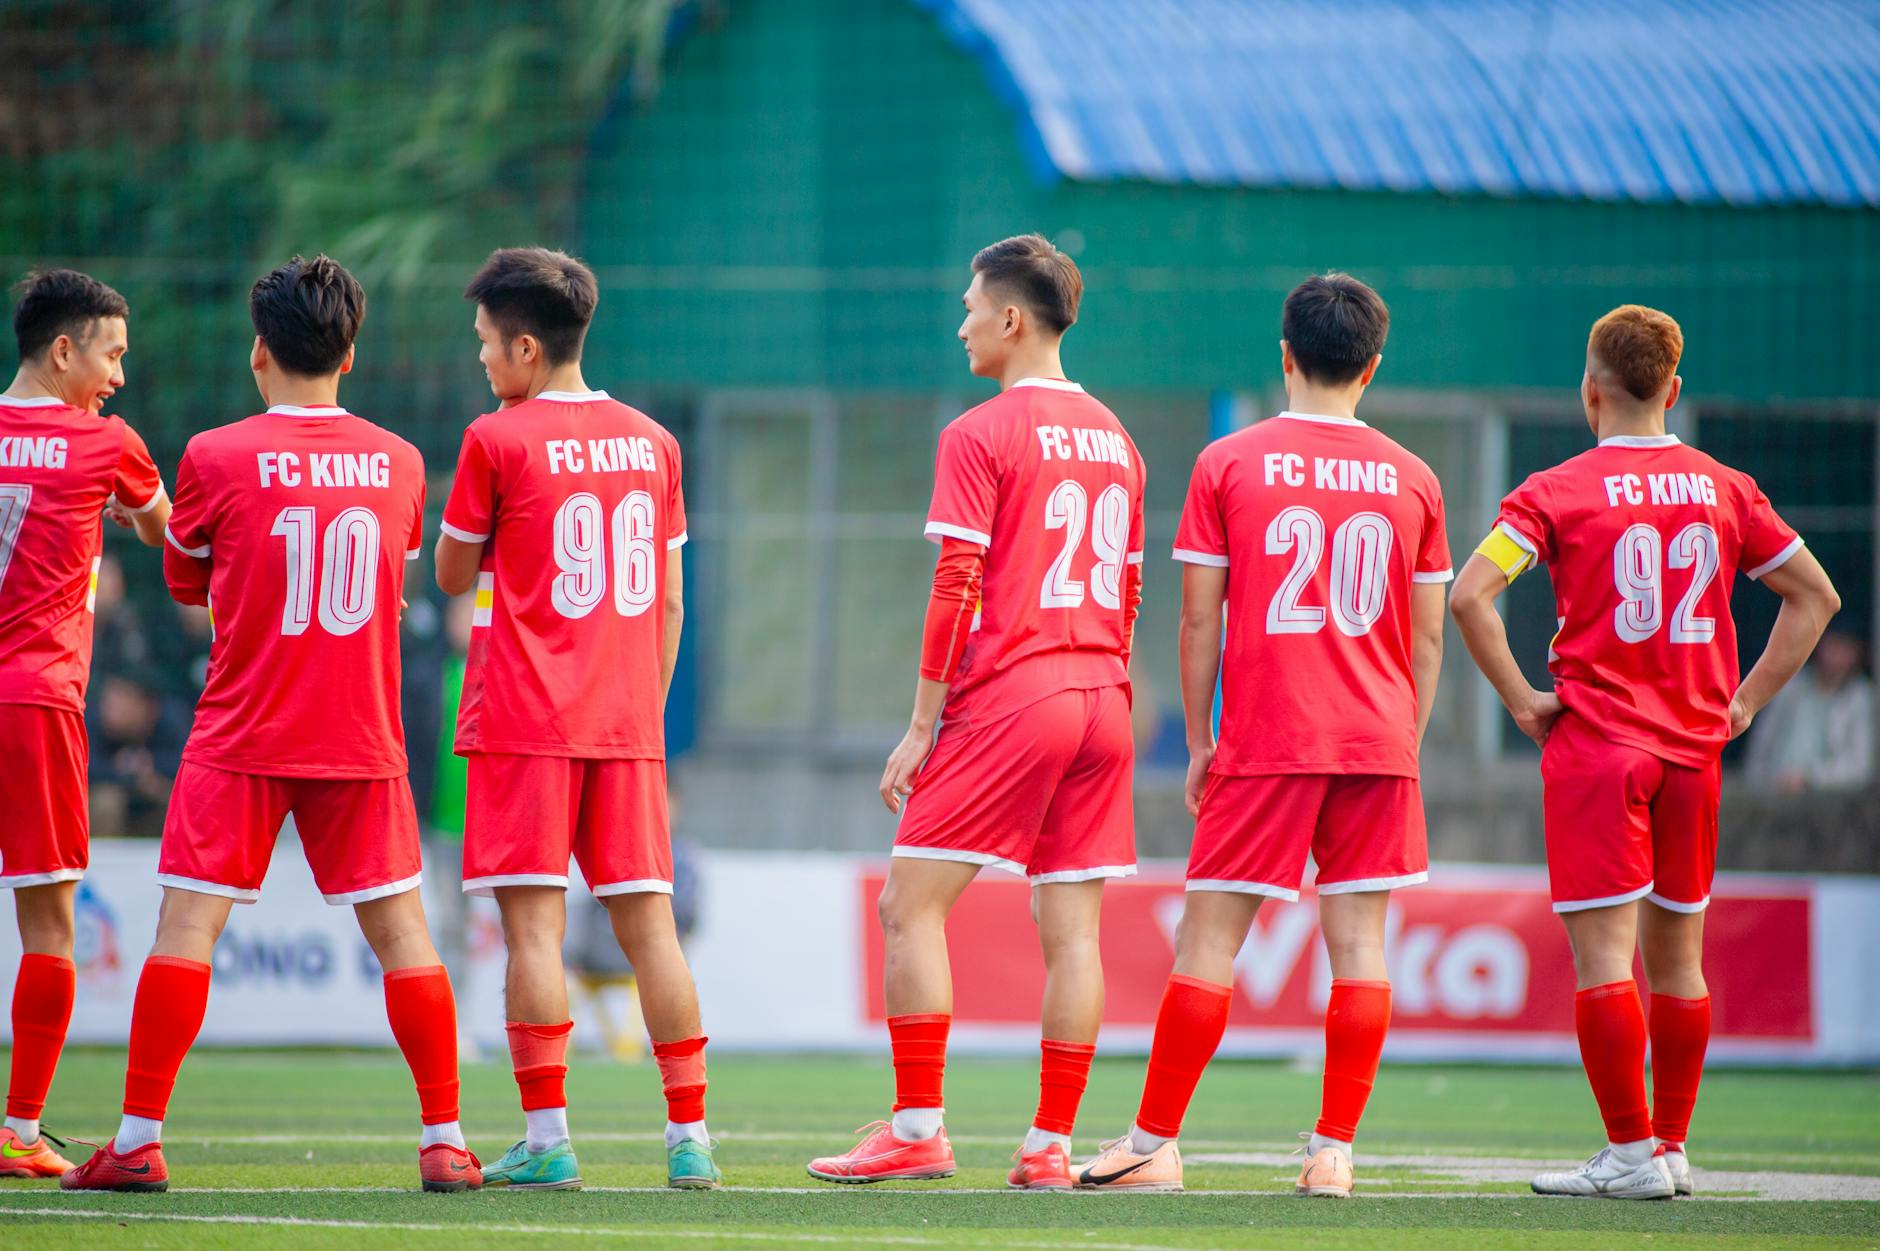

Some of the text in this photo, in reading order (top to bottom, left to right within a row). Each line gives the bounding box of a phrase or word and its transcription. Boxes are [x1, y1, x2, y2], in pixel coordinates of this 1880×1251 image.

[257, 451, 390, 488] FC KING
[545, 436, 657, 475] FC KING
[1036, 425, 1130, 470] FC KING
[1263, 452, 1398, 497] FC KING
[1603, 472, 1718, 508] FC KING
[270, 506, 381, 636] 10
[551, 489, 656, 619] 96
[1039, 479, 1130, 610] 29
[1265, 505, 1394, 637] 20
[1614, 522, 1720, 644] 92
